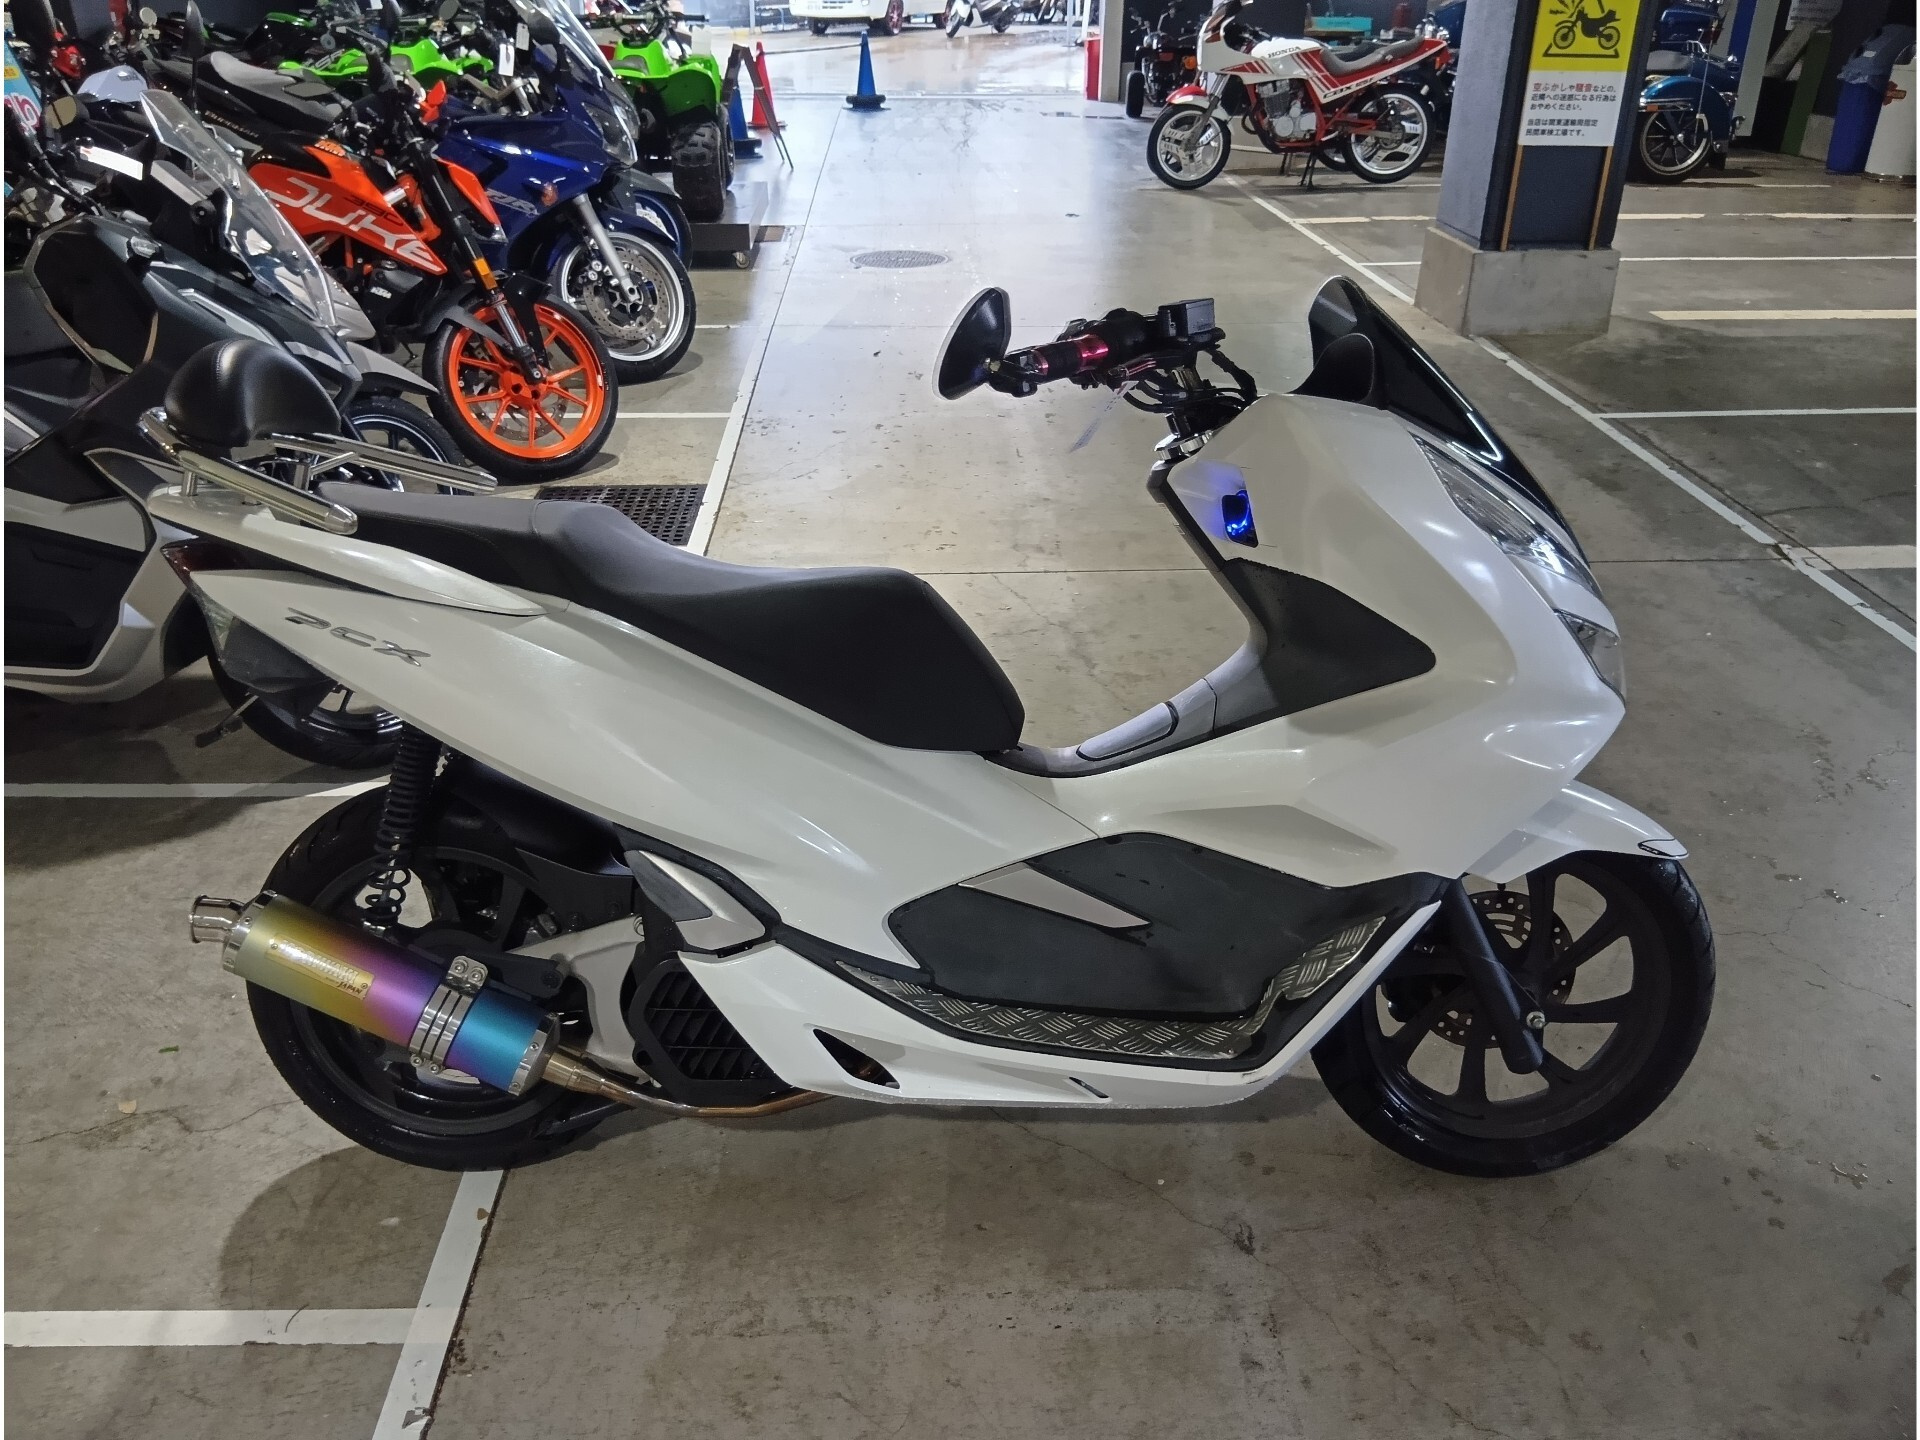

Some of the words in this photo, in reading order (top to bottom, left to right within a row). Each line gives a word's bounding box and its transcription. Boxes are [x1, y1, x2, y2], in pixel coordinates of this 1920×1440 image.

[1268, 46, 1302, 58] HONDA
[265, 176, 443, 272] DUKE
[284, 606, 432, 667] PCX
[336, 981, 363, 995] JAPAN
